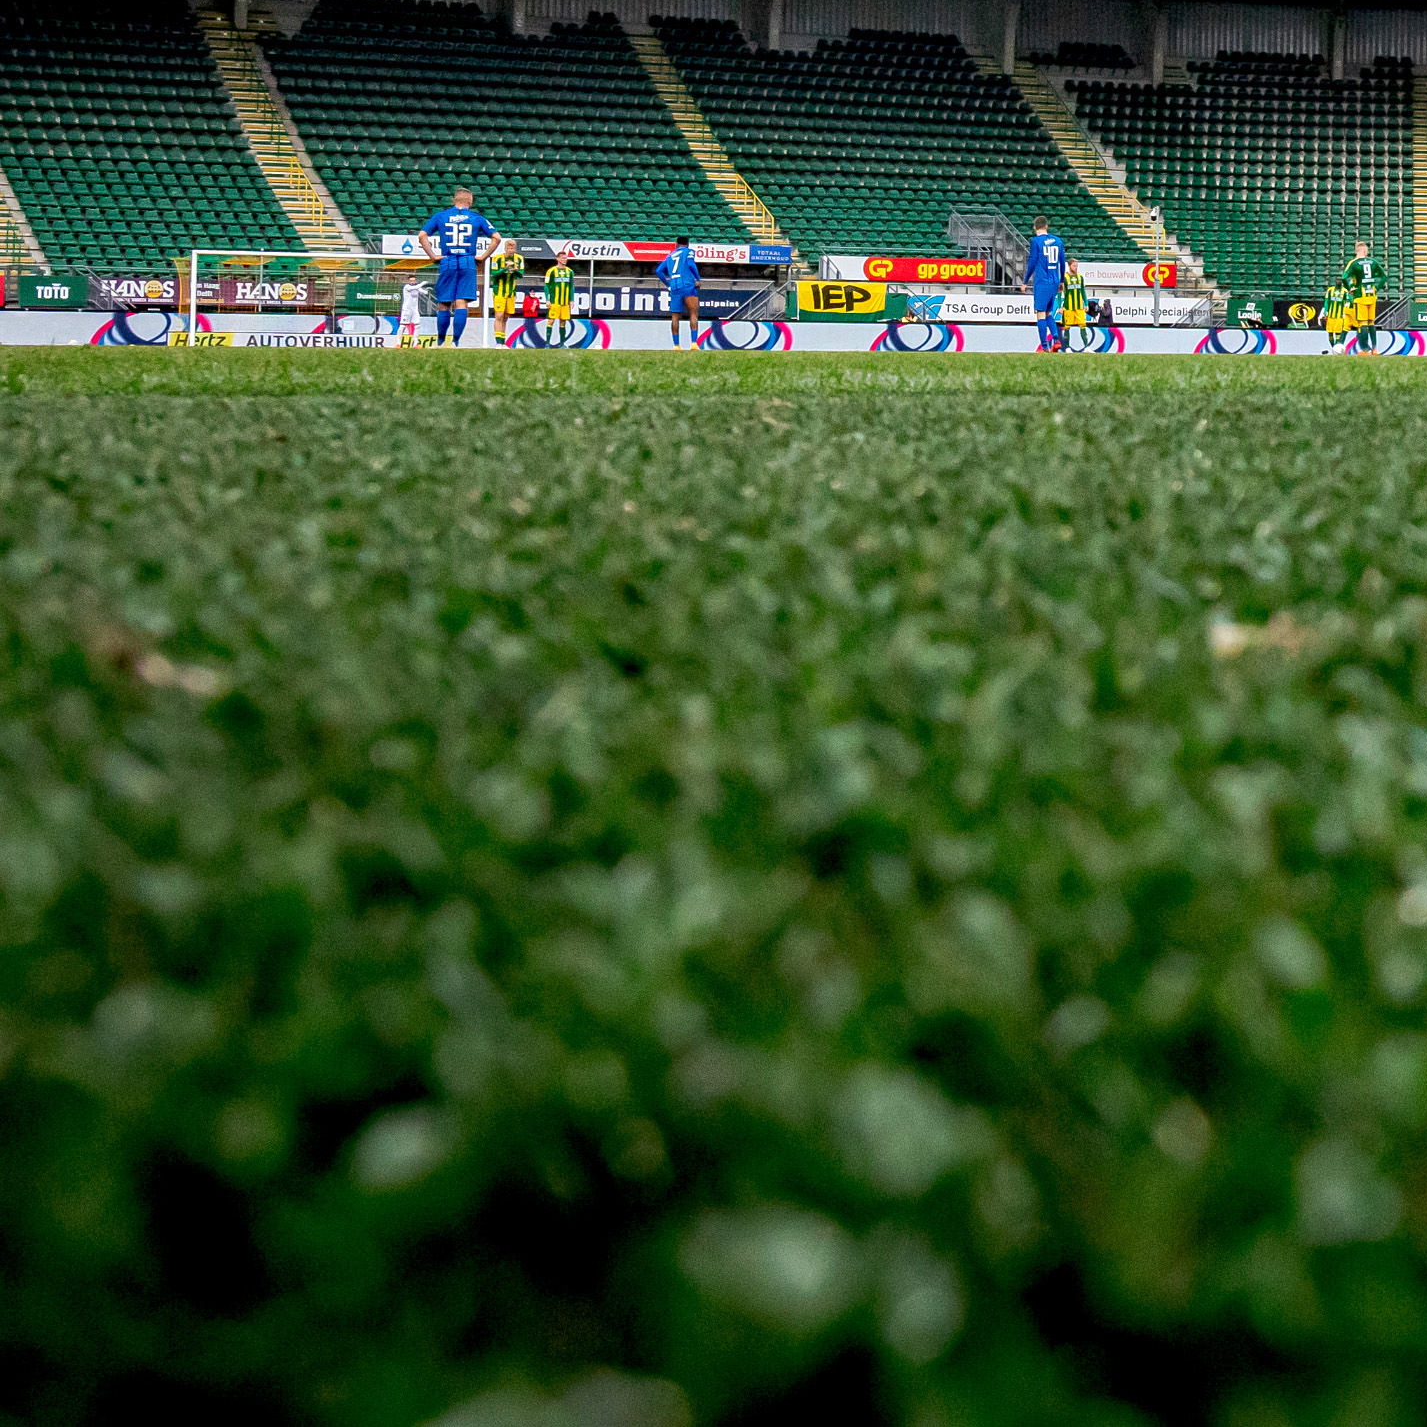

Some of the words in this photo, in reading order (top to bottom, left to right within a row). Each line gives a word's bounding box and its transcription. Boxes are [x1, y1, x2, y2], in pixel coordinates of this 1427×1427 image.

[444, 223, 472, 247] 32
[572, 243, 621, 257] Bustin
[696, 245, 746, 262] öling's
[1042, 245, 1059, 264] 40
[673, 257, 681, 273] 7
[917, 263, 938, 280] gp
[940, 262, 984, 280] groot
[1363, 264, 1372, 278] 9
[1097, 270, 1138, 279] bouwafval
[36, 283, 69, 299] TOTO
[100, 280, 174, 298] HANOS
[235, 282, 308, 301] HANOS
[811, 283, 872, 312] IEP
[945, 303, 967, 314] TSA
[972, 303, 1003, 317] Group
[1006, 304, 1030, 315] Delft
[1115, 306, 1147, 318] Delphi
[246, 335, 385, 348] AUTOVERHUUR
[400, 336, 436, 348] Hrt
